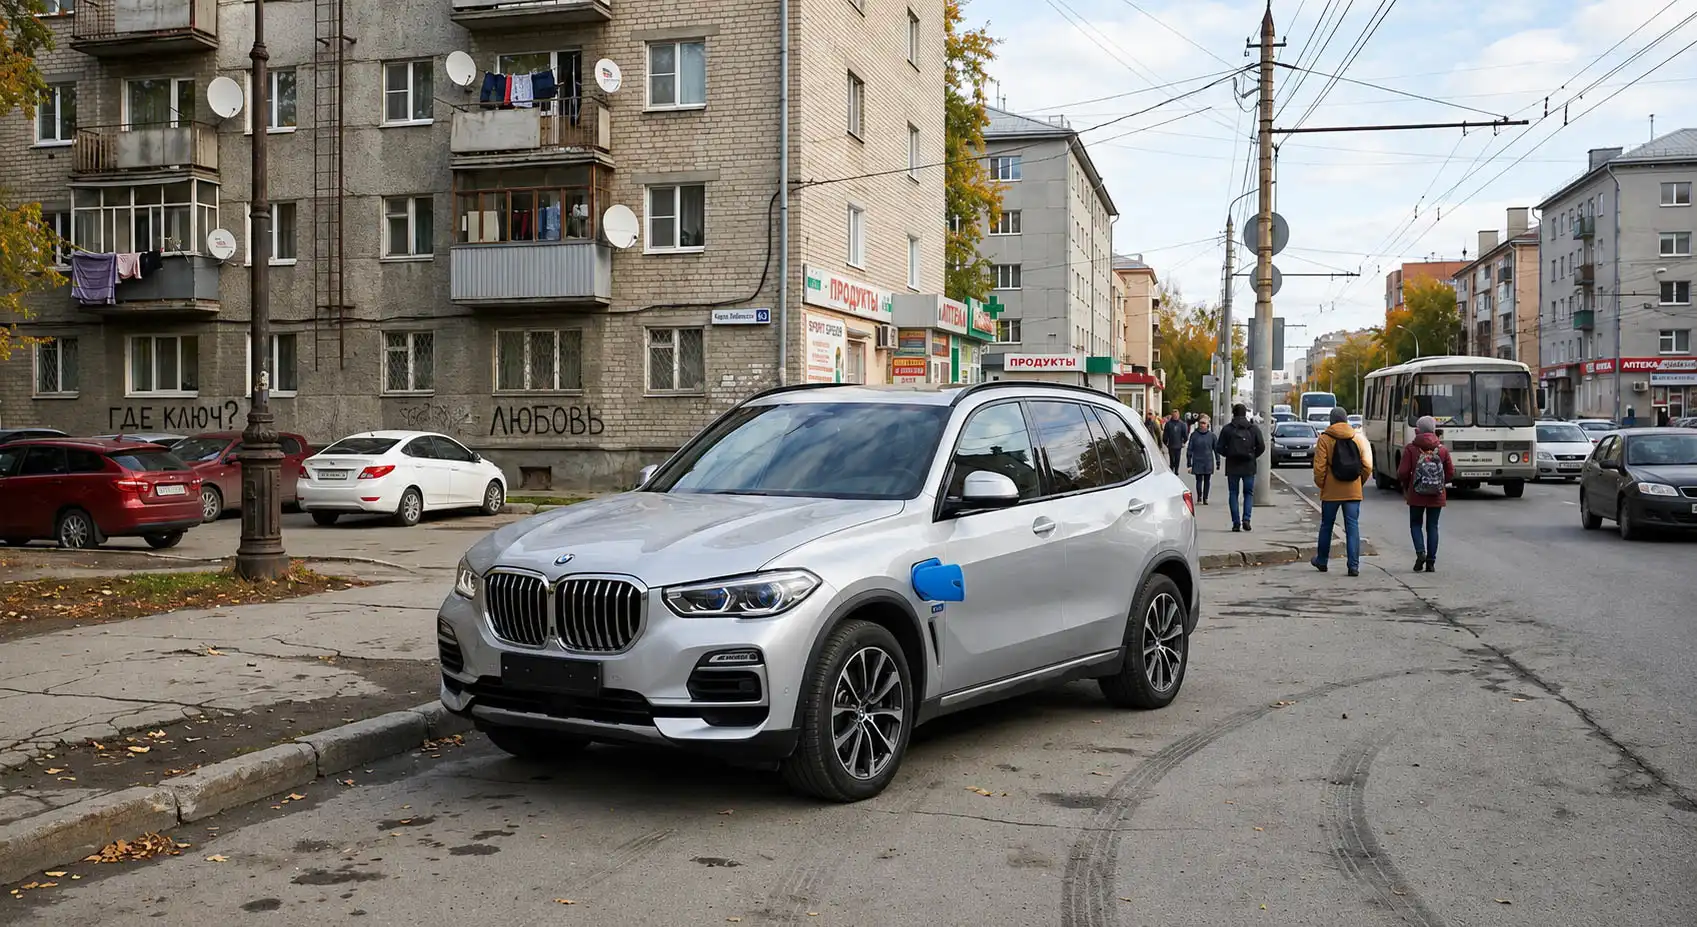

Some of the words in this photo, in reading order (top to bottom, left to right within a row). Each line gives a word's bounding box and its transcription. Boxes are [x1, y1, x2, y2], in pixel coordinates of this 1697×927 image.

[830, 277, 879, 312] ПРОДУКТЫ
[1010, 357, 1076, 368] ПРОДУКТЫ
[1623, 361, 1658, 369] АПТЕКА
[109, 406, 153, 430] ГДЕ
[163, 400, 239, 430] КЛЮЧ?
[490, 405, 605, 436] ЛЮБОВЬ
